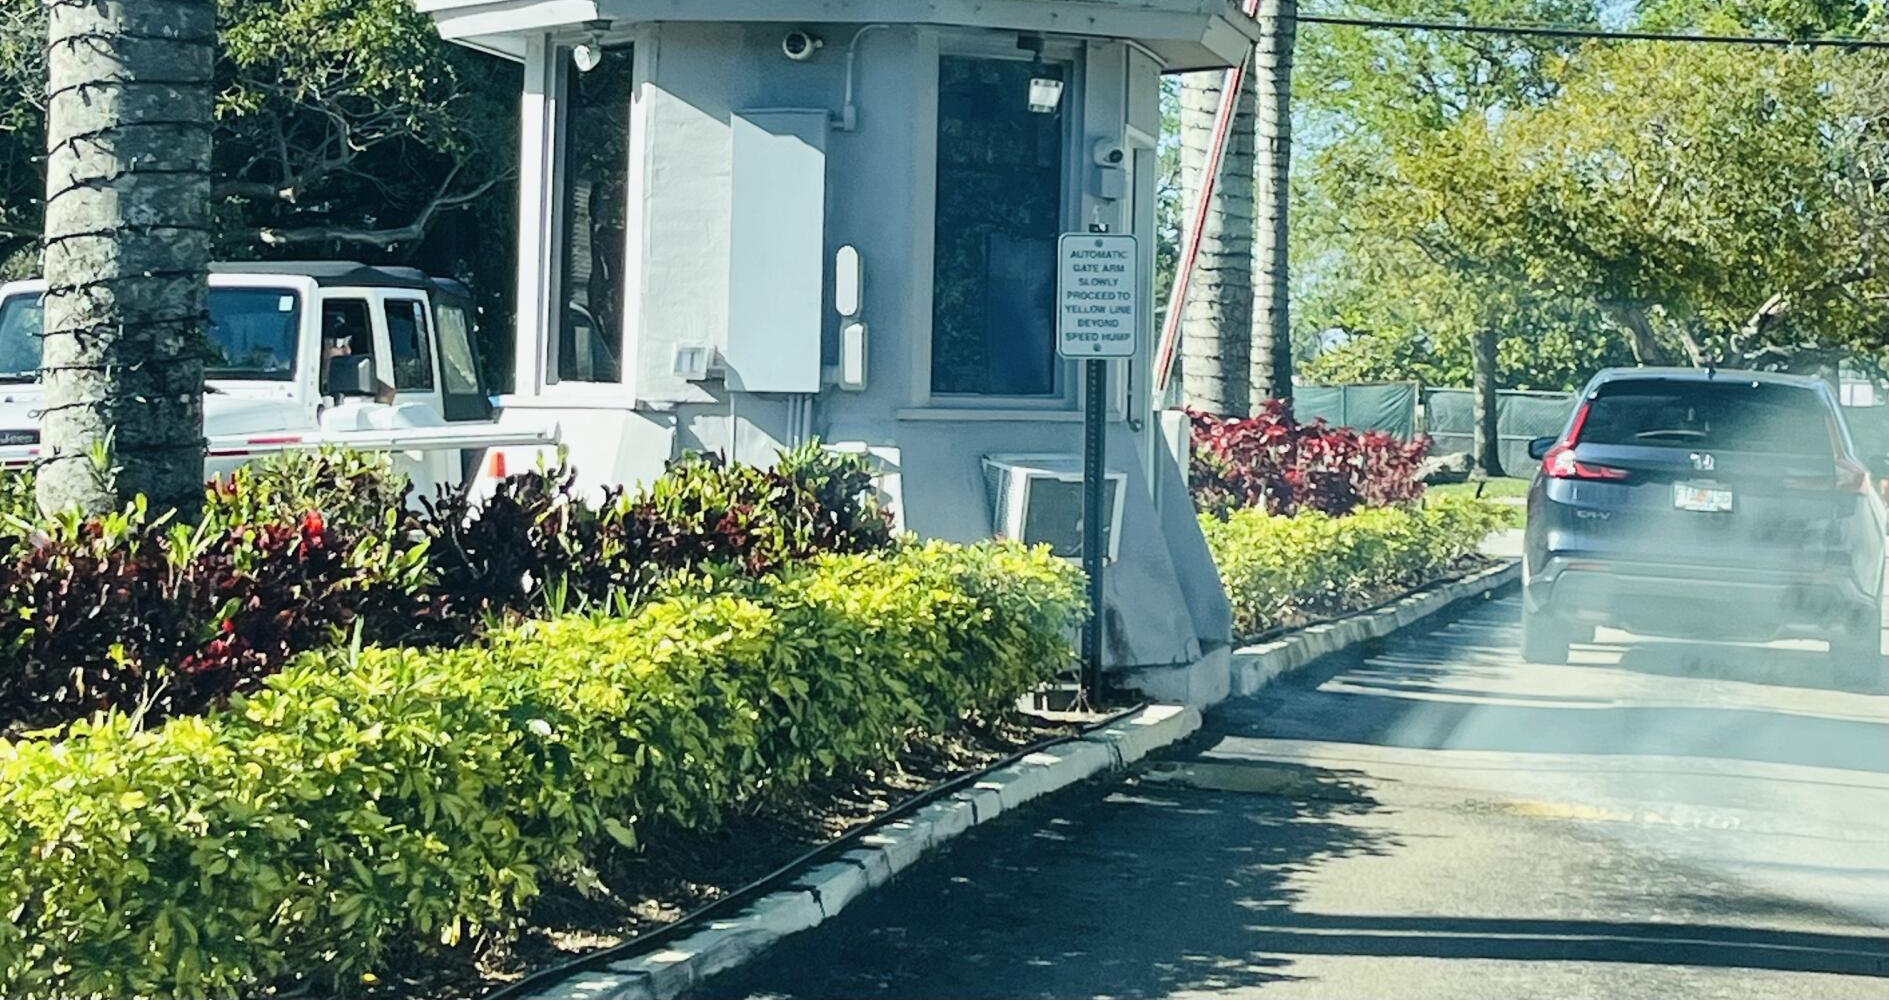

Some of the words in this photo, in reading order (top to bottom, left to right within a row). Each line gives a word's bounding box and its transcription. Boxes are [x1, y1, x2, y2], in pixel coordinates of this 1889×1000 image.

[1070, 250, 1127, 258] AUTOMATIC
[1073, 264, 1099, 272] GATE
[1102, 264, 1124, 272] ARM
[1078, 278, 1118, 286] SLOWLY
[1066, 291, 1115, 300] PROCEED
[1117, 292, 1130, 300] TO
[1065, 305, 1105, 314] YELLOW
[1109, 306, 1131, 314] LINE
[1077, 319, 1118, 327] BEYOND
[1065, 332, 1098, 341] SPEED
[1101, 333, 1131, 341] HUMP
